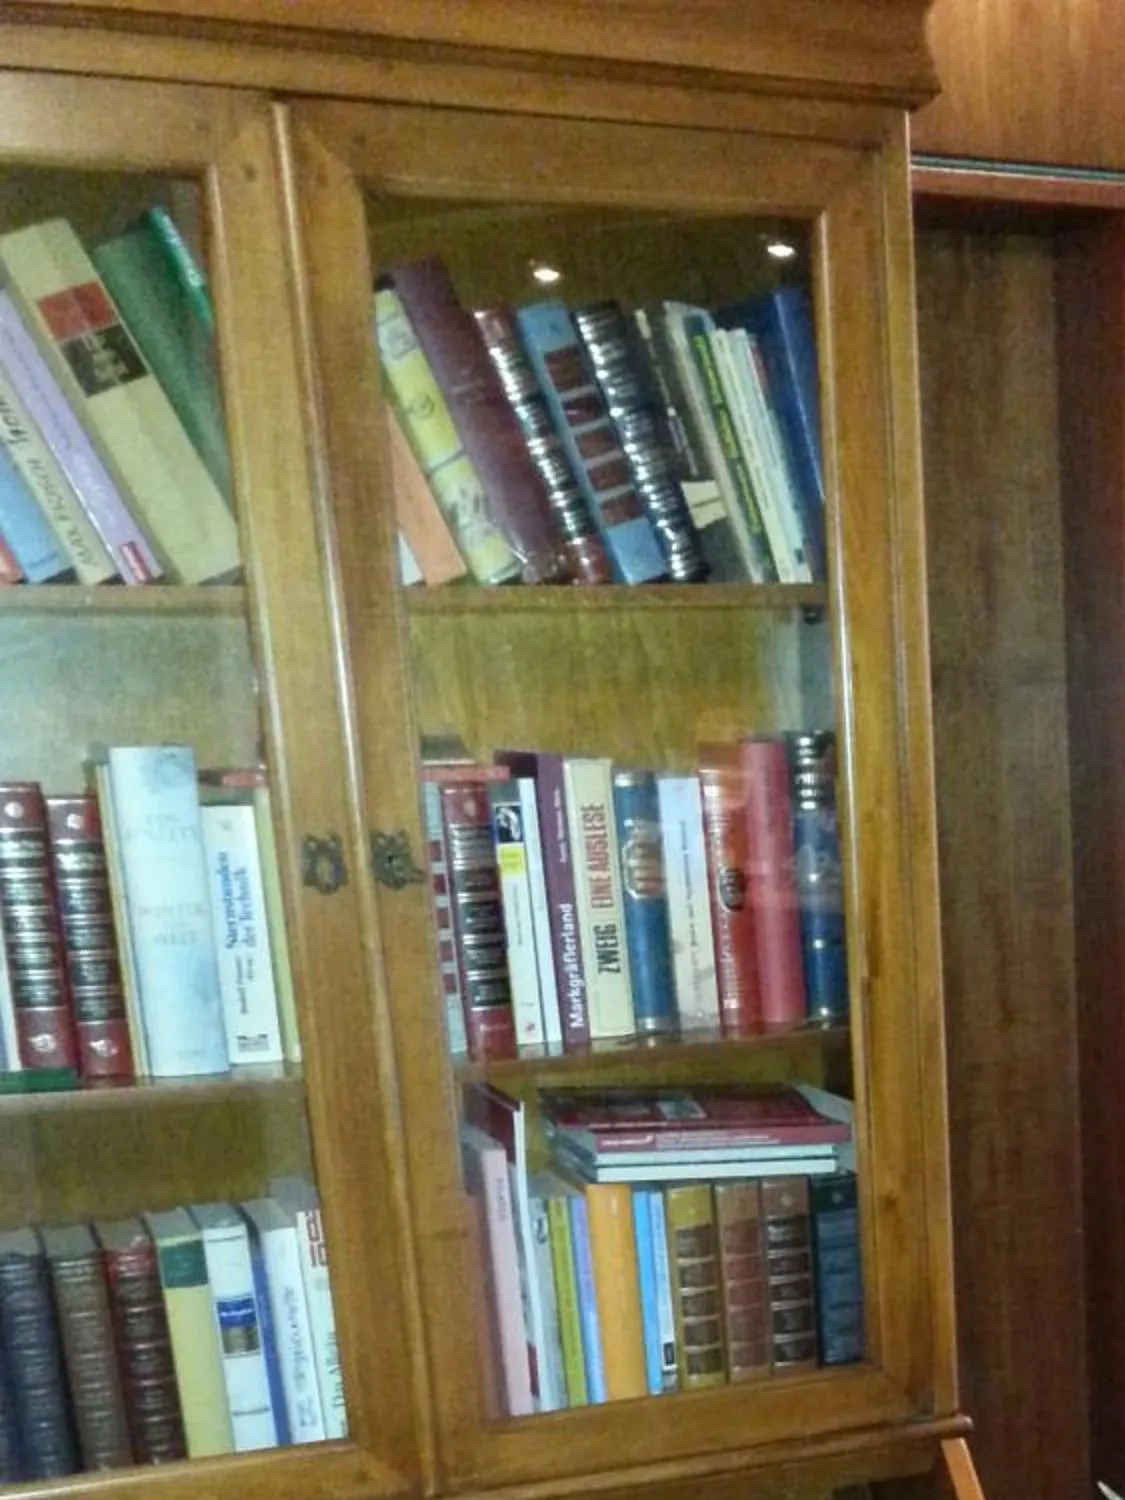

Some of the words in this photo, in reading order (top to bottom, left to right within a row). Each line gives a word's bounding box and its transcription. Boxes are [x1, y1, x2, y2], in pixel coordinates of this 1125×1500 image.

[581, 803, 612, 873] AUSLESE
[588, 874, 614, 910] EINE
[559, 903, 585, 1028] Markgräflerland
[592, 921, 621, 975] ZWEIG
